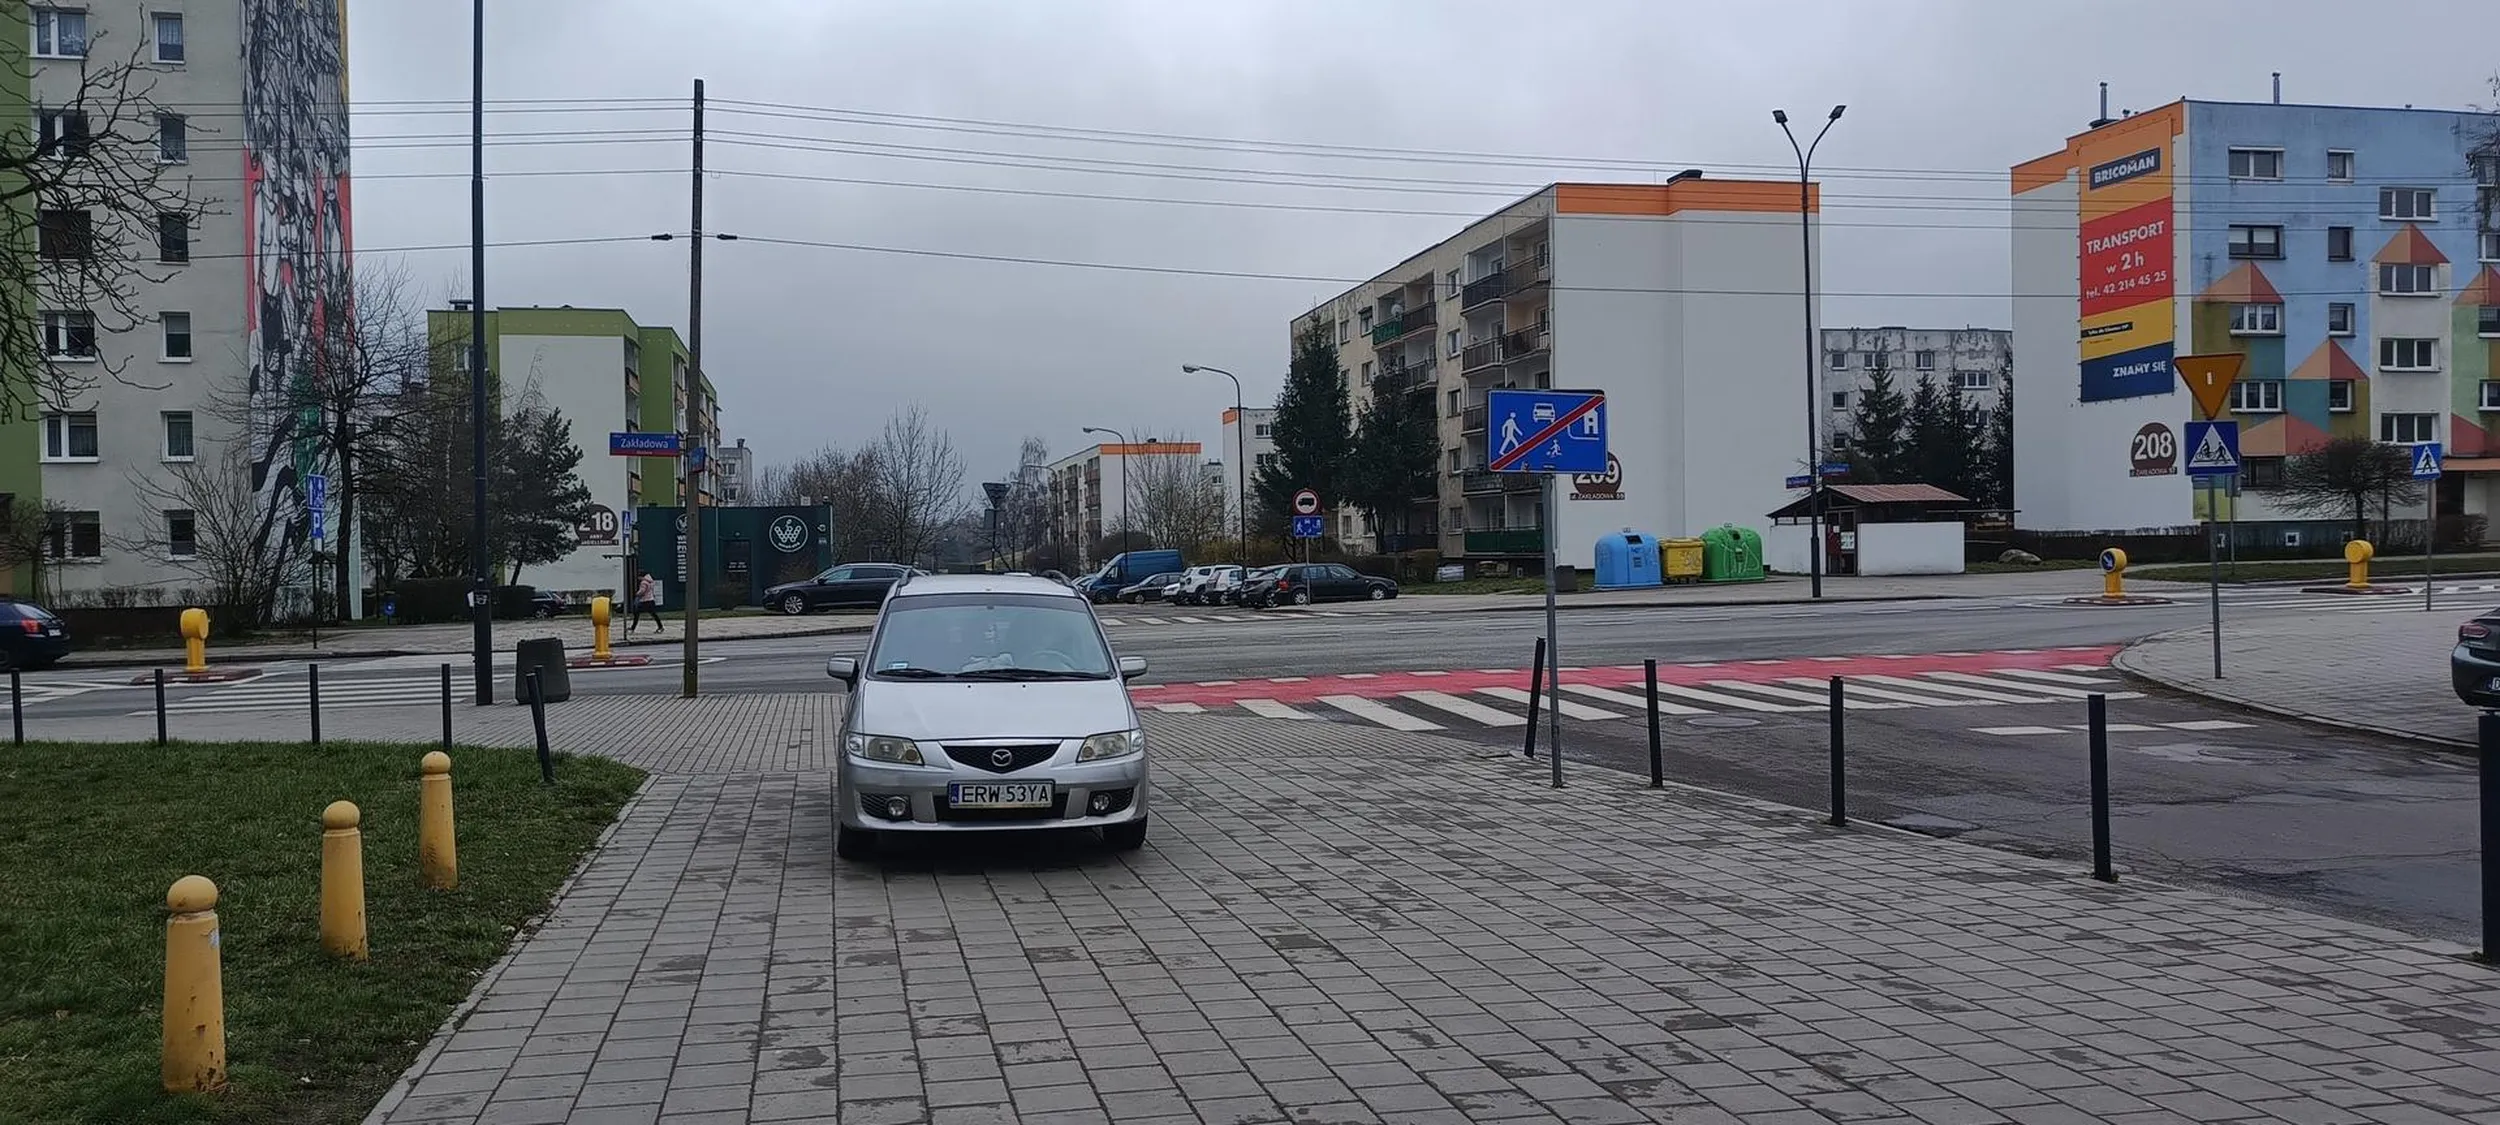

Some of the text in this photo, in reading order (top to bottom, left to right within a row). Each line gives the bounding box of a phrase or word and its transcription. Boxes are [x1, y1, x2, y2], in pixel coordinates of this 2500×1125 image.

[2094, 155, 2156, 184] BRICOMAN
[2086, 221, 2165, 254] TRANSPORT
[2105, 251, 2145, 274] w 2 h
[2086, 270, 2167, 299] tel. 42 214 45 25
[2113, 361, 2167, 378] ZNAMY SIĘ
[620, 438, 669, 448] Zakładowa
[2134, 431, 2173, 460] 208
[578, 511, 614, 531] 218
[962, 785, 1049, 803] ERW 53YA
